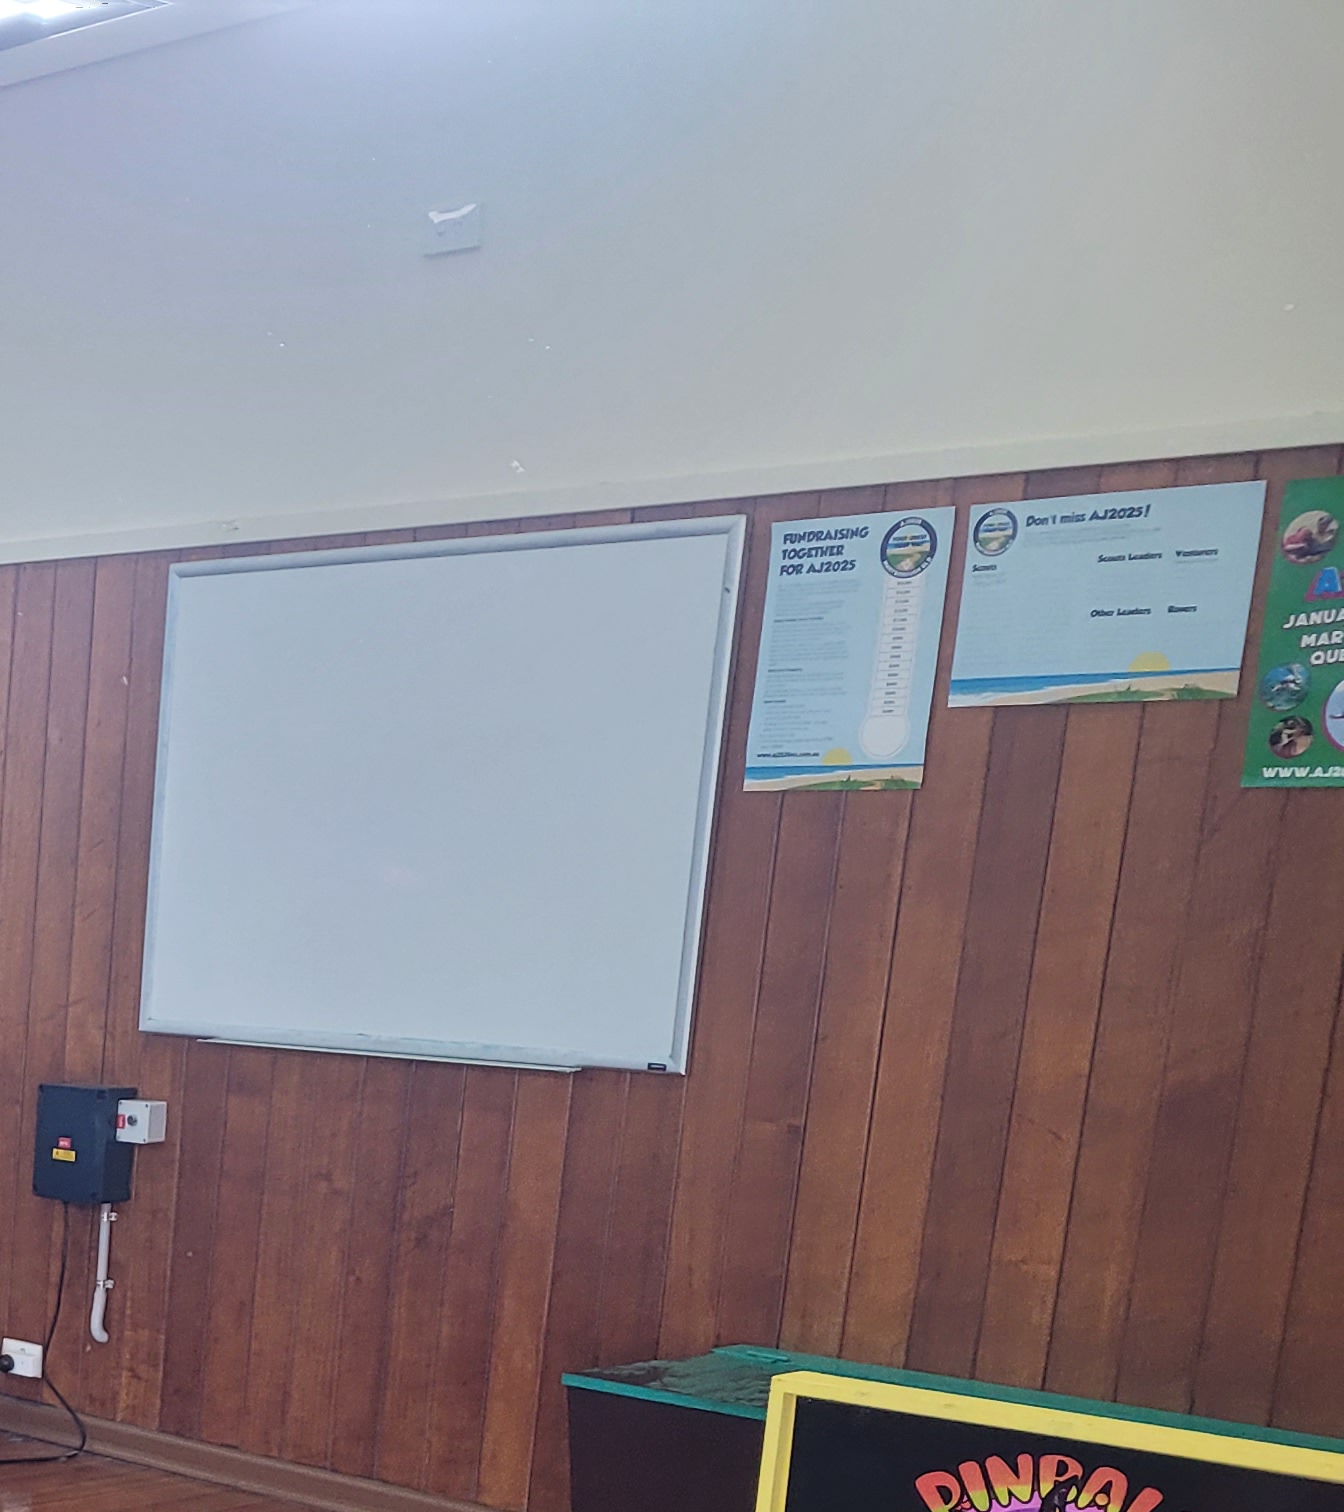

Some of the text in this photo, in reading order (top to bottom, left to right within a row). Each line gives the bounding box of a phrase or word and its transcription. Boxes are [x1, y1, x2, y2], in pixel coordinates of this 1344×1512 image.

[1089, 504, 1151, 521] AJ2025!
[783, 526, 869, 545] FUNDRAISING
[781, 545, 844, 560] TOGETHER
[779, 559, 857, 576] FOR AJ2025
[1282, 607, 1344, 629] JANUA
[1300, 630, 1344, 649] MAR
[1310, 647, 1344, 666] QUE
[1262, 766, 1344, 779] WWW.AJ2
